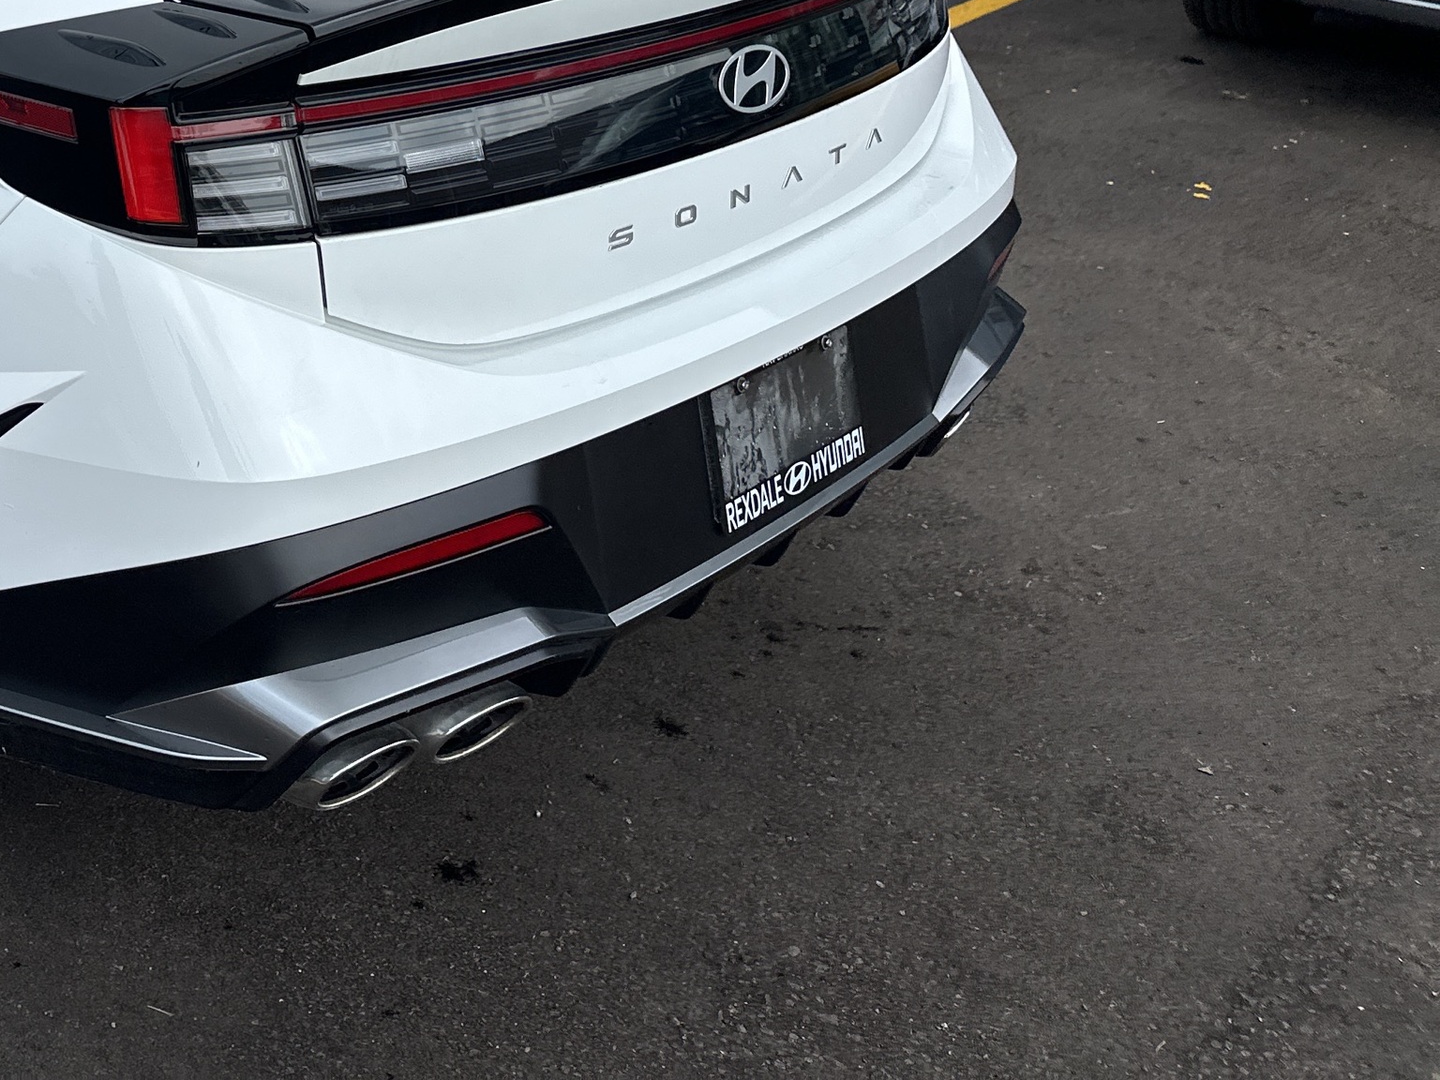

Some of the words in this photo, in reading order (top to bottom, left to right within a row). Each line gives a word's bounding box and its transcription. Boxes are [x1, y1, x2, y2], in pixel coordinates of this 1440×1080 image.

[607, 127, 883, 252] SONATA
[810, 426, 866, 483] HYUNDAI
[725, 473, 785, 534] REXDALE
